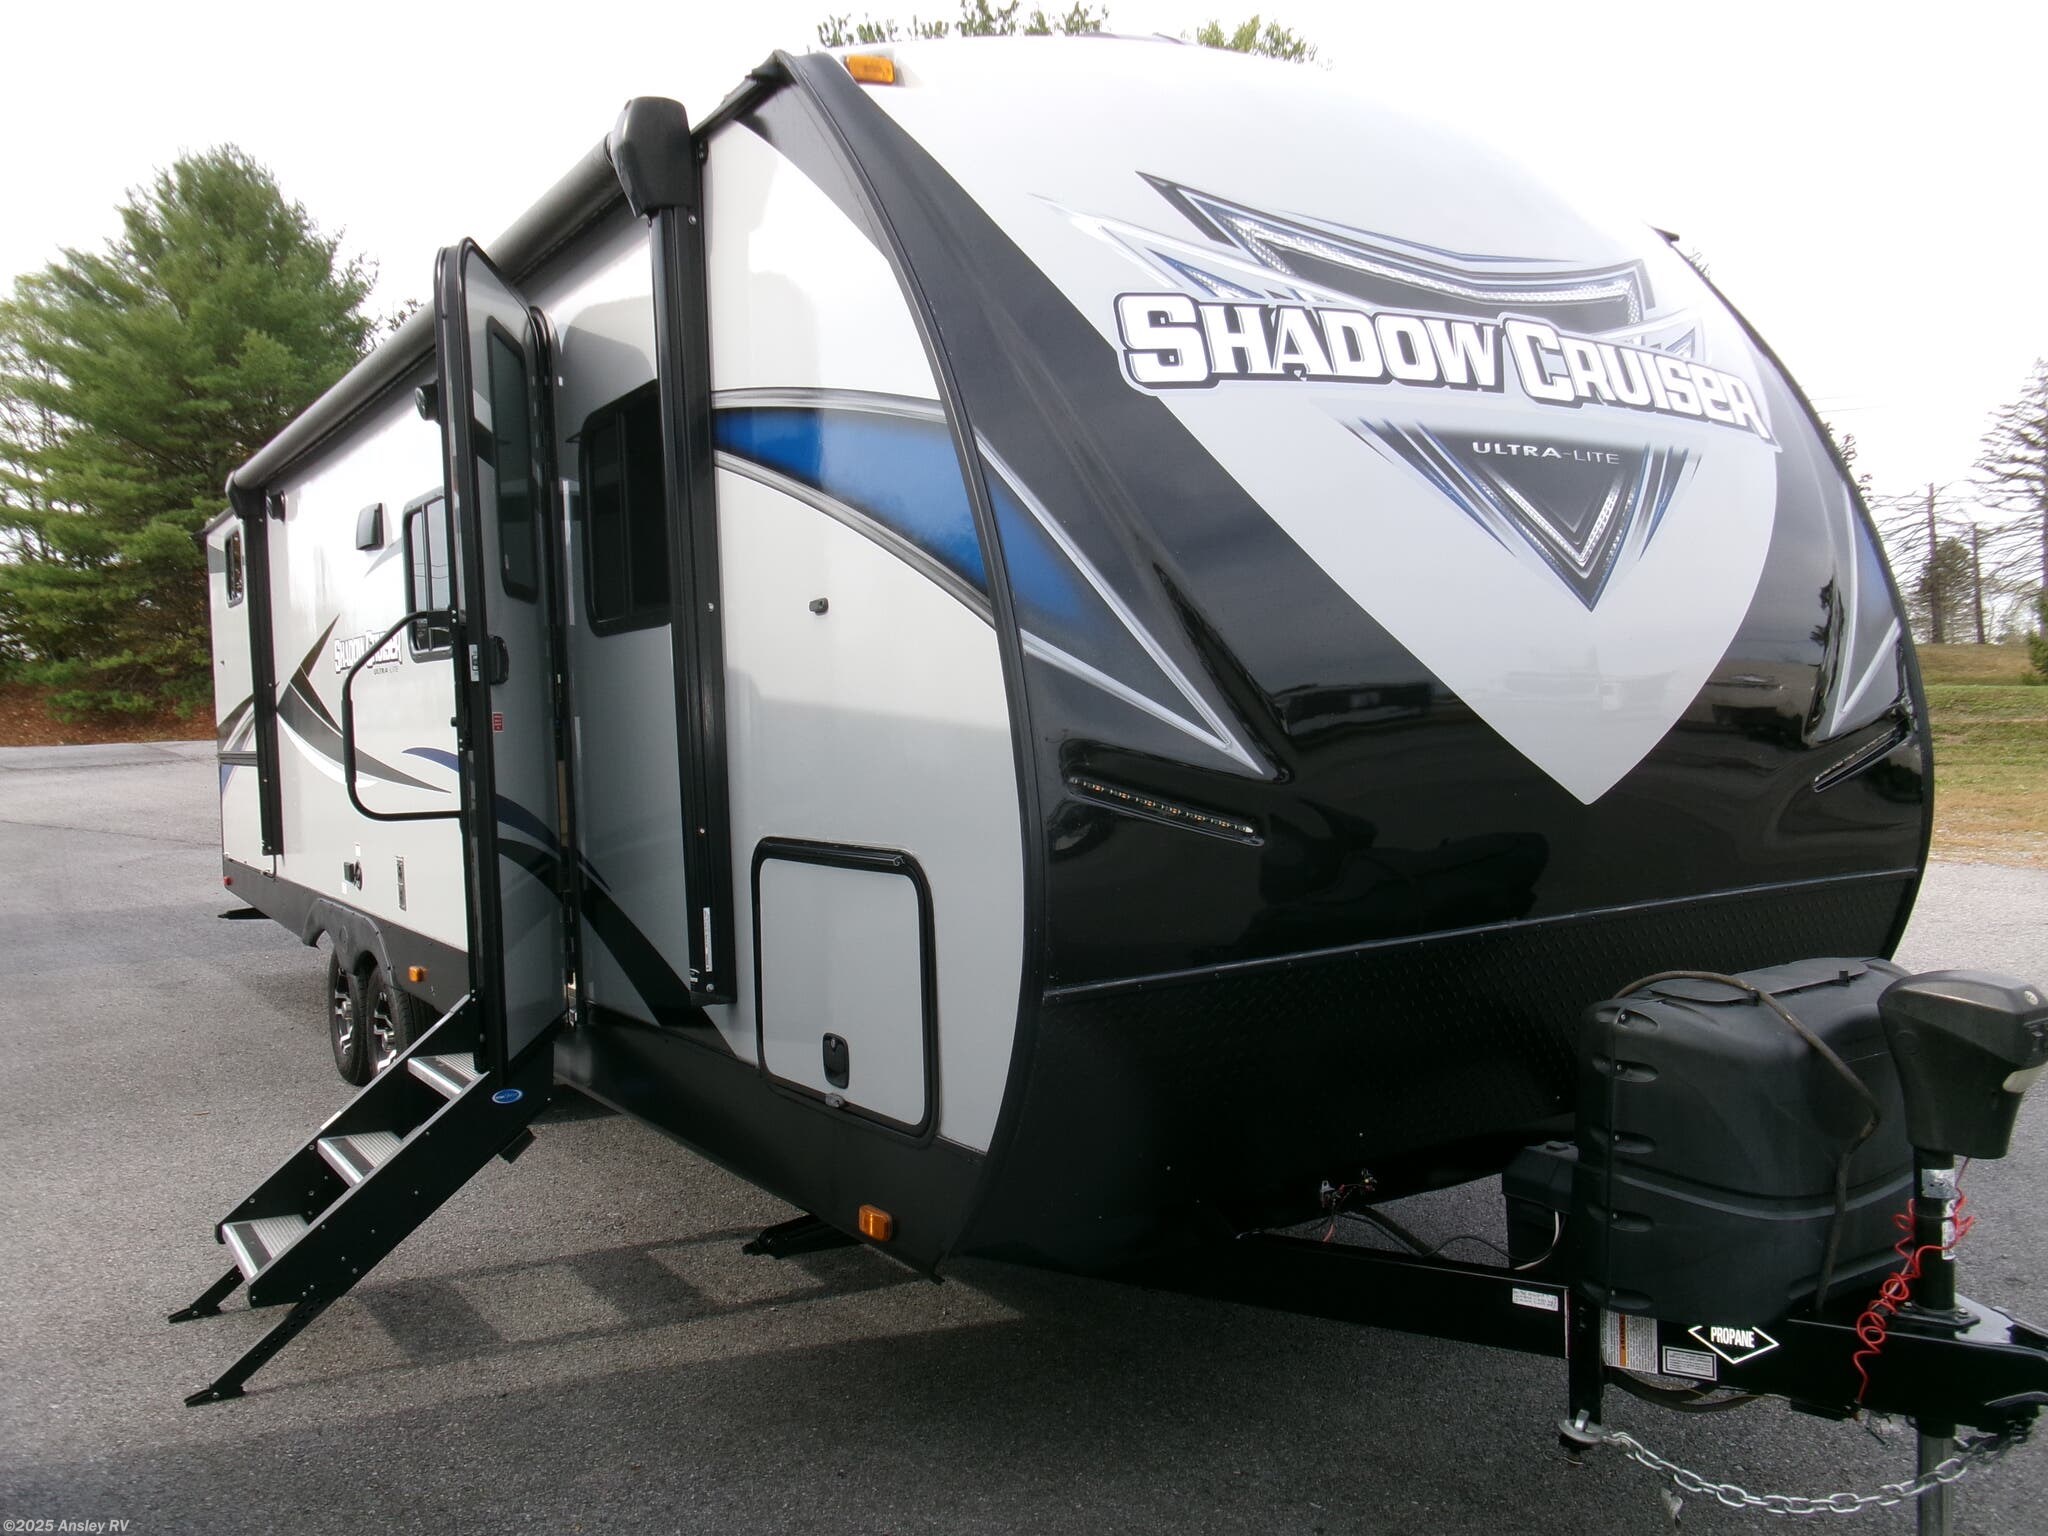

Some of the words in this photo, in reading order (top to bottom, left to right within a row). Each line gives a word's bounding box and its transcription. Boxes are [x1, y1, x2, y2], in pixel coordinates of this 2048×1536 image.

[1118, 295, 1502, 391] SHADOW
[1501, 316, 1772, 440] CRUISER
[1472, 441, 1620, 464] ULTRA-LITE
[1710, 1326, 1755, 1349] PROPANE
